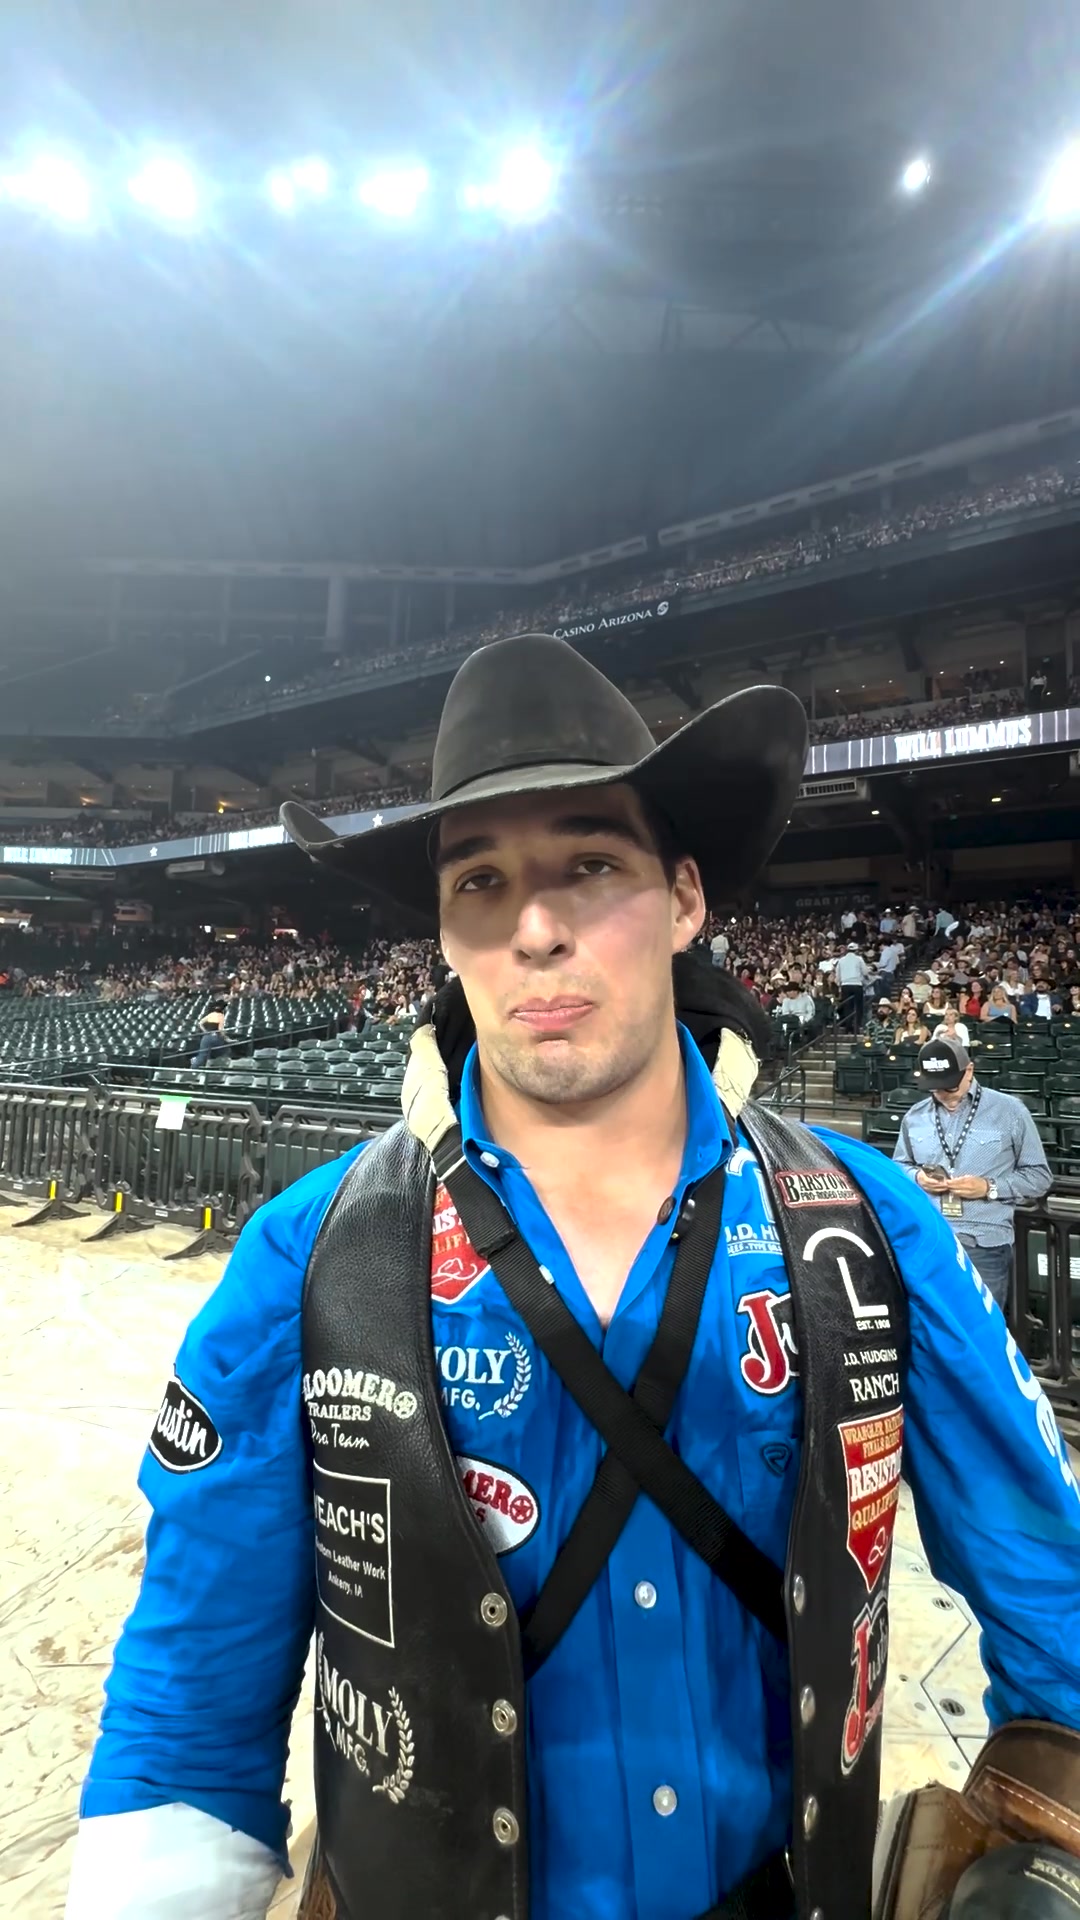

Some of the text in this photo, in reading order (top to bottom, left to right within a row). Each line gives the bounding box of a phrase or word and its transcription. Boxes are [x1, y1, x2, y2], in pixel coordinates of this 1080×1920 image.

[553, 609, 652, 639] CASINO ARIZONA
[894, 717, 1032, 763] WILL LUMMUS
[782, 1173, 850, 1202] BARSTOW
[856, 1321, 875, 1331] EST.
[434, 1345, 512, 1384] OLY
[843, 1348, 898, 1367] J.D. HUDGINS
[302, 1366, 396, 1412] LOOMER
[849, 1372, 900, 1402] RANCH
[307, 1401, 372, 1421] TRAILERS
[157, 1397, 207, 1458] ustin
[330, 1423, 370, 1449] Team
[848, 1447, 902, 1502] RESIST
[333, 1550, 360, 1572] Leather
[362, 1561, 386, 1580] Work
[354, 1583, 363, 1598] IA
[323, 1654, 392, 1757] MOLY
[336, 1721, 371, 1778] MFG.
